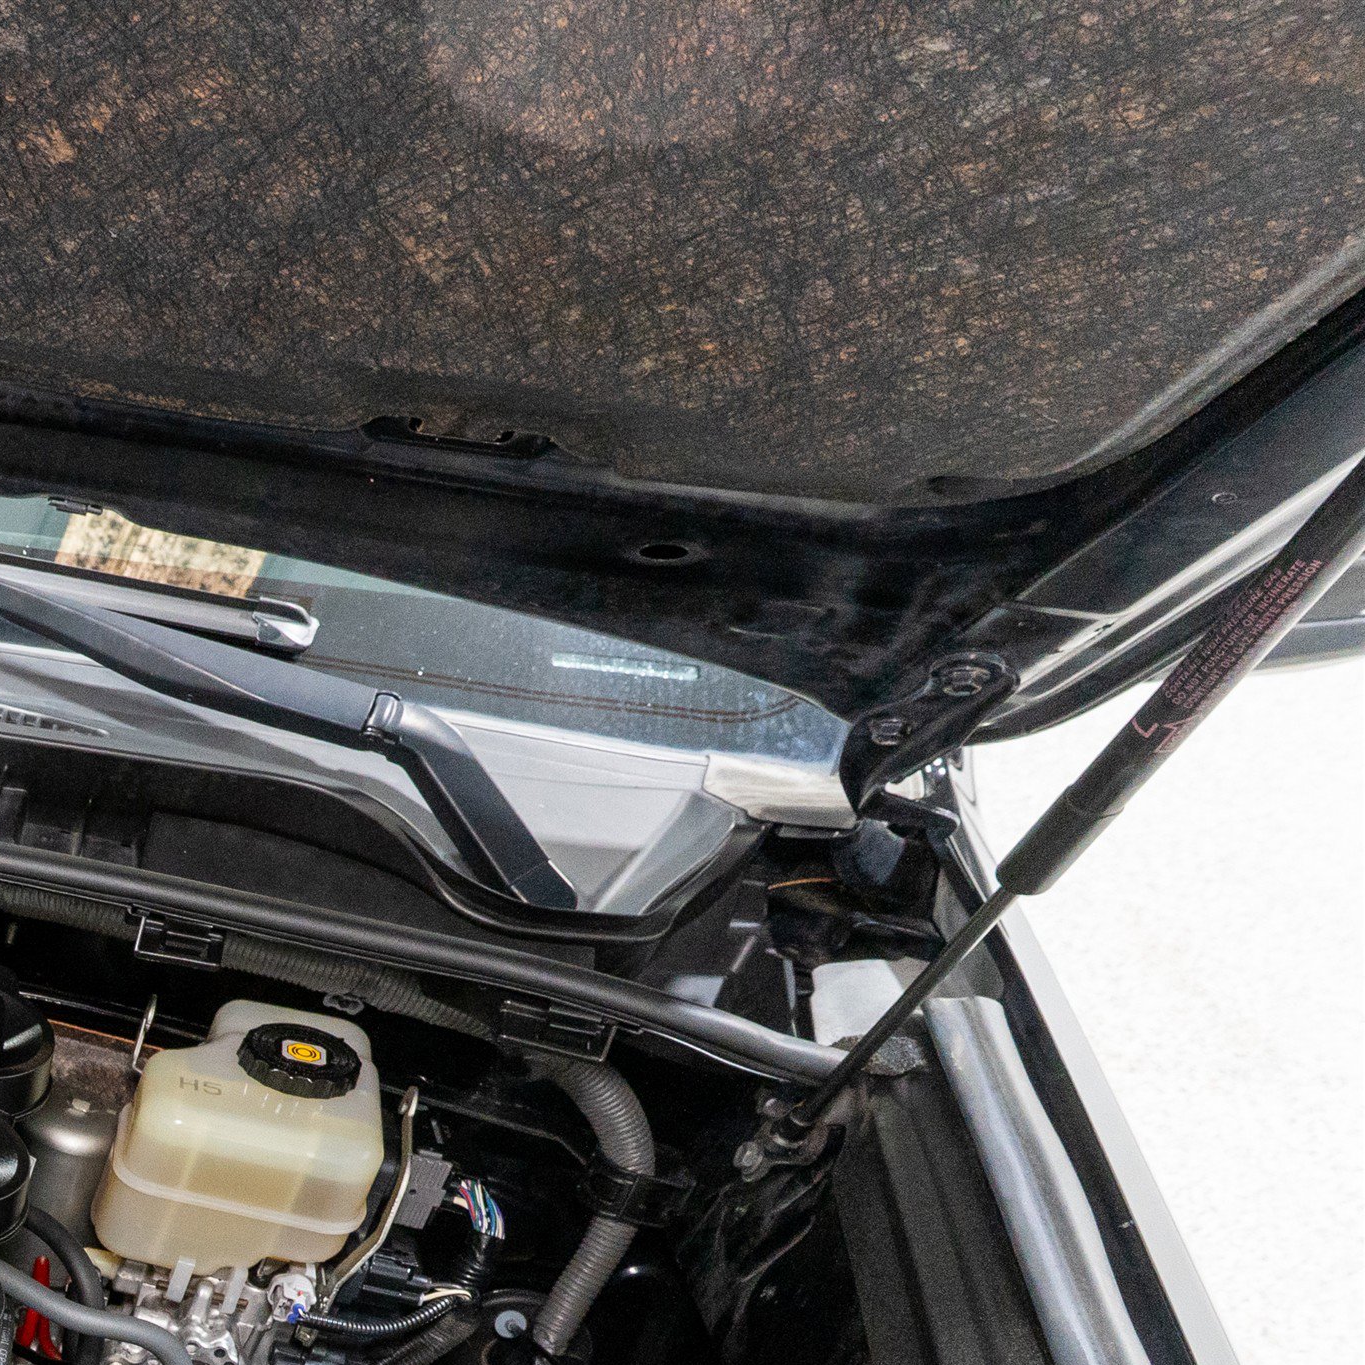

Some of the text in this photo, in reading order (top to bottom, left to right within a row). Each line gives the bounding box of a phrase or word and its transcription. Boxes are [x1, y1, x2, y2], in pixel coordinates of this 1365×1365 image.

[1200, 626, 1244, 673] PUNCTURE
[1241, 610, 1259, 628] OR
[1254, 557, 1306, 613] INCINERATE
[1275, 557, 1322, 606] PRESSION
